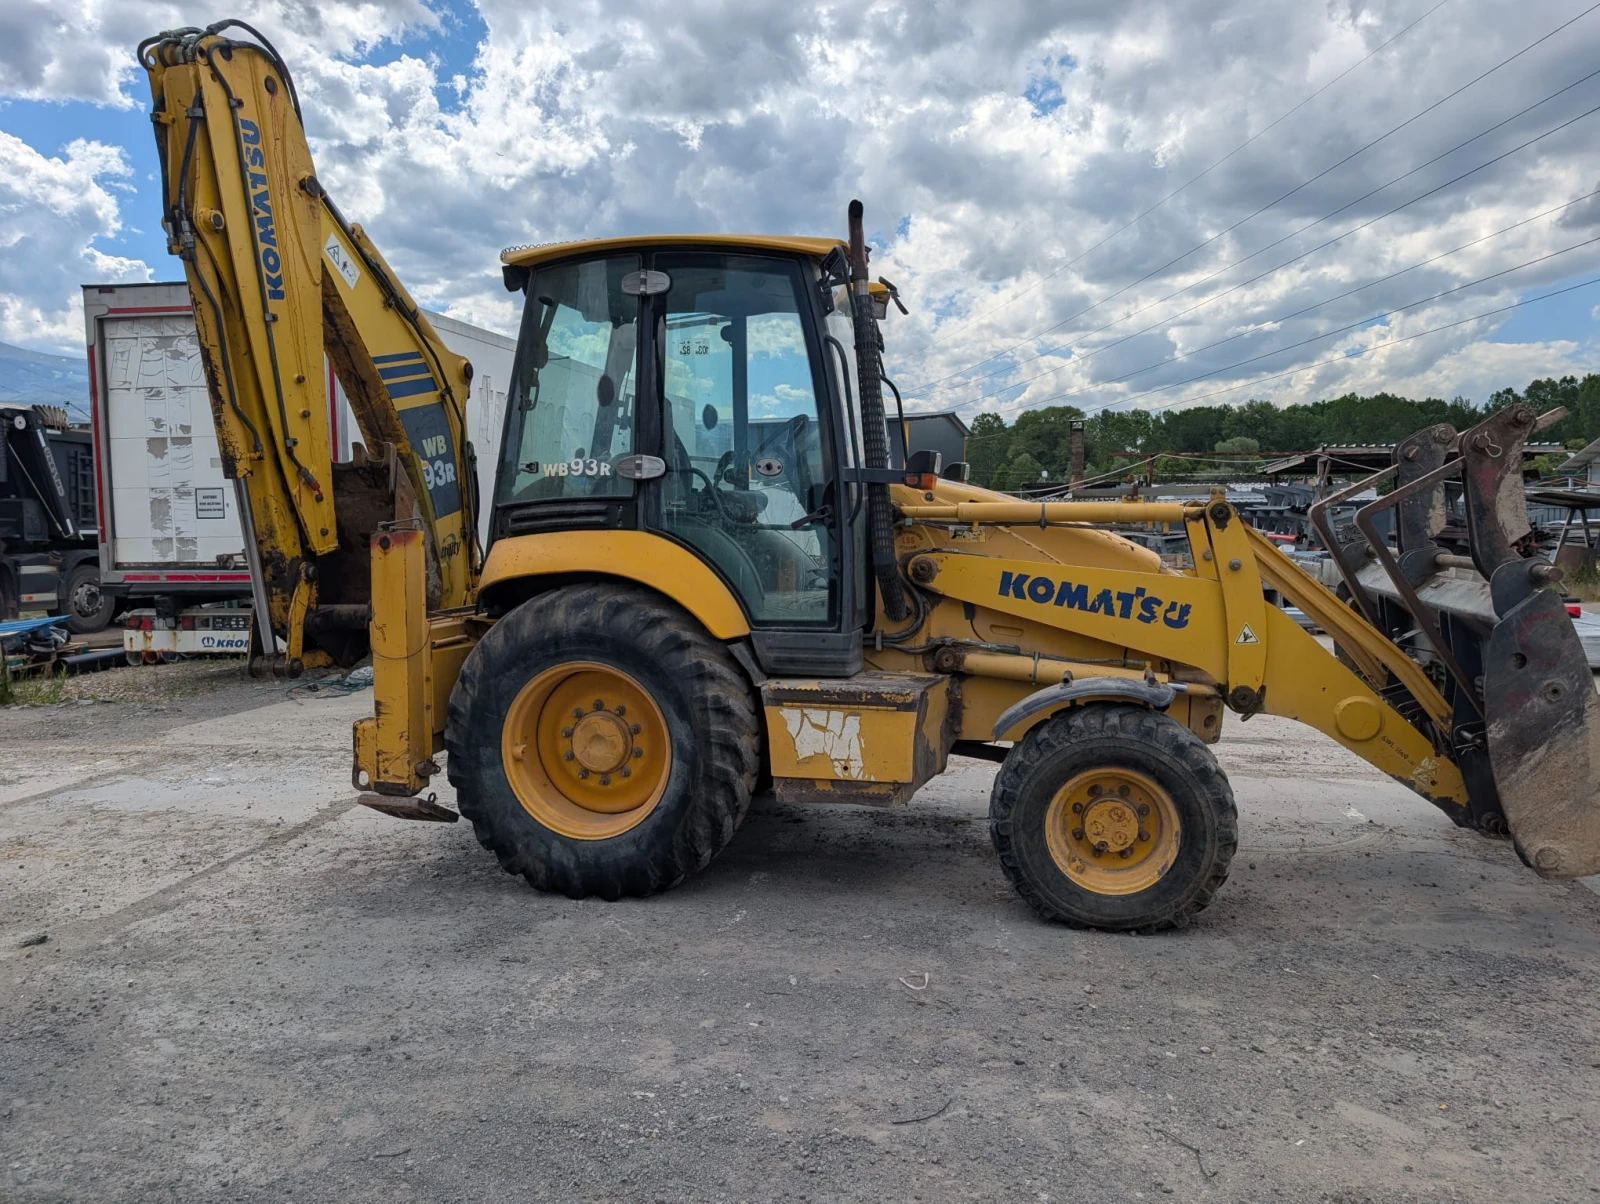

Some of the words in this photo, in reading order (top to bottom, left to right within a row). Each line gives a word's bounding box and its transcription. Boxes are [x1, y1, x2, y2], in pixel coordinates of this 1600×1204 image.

[240, 118, 285, 300] KOMATSU
[422, 435, 447, 458] WB
[423, 460, 456, 490] 93R
[998, 570, 1192, 629] KOMATSU
